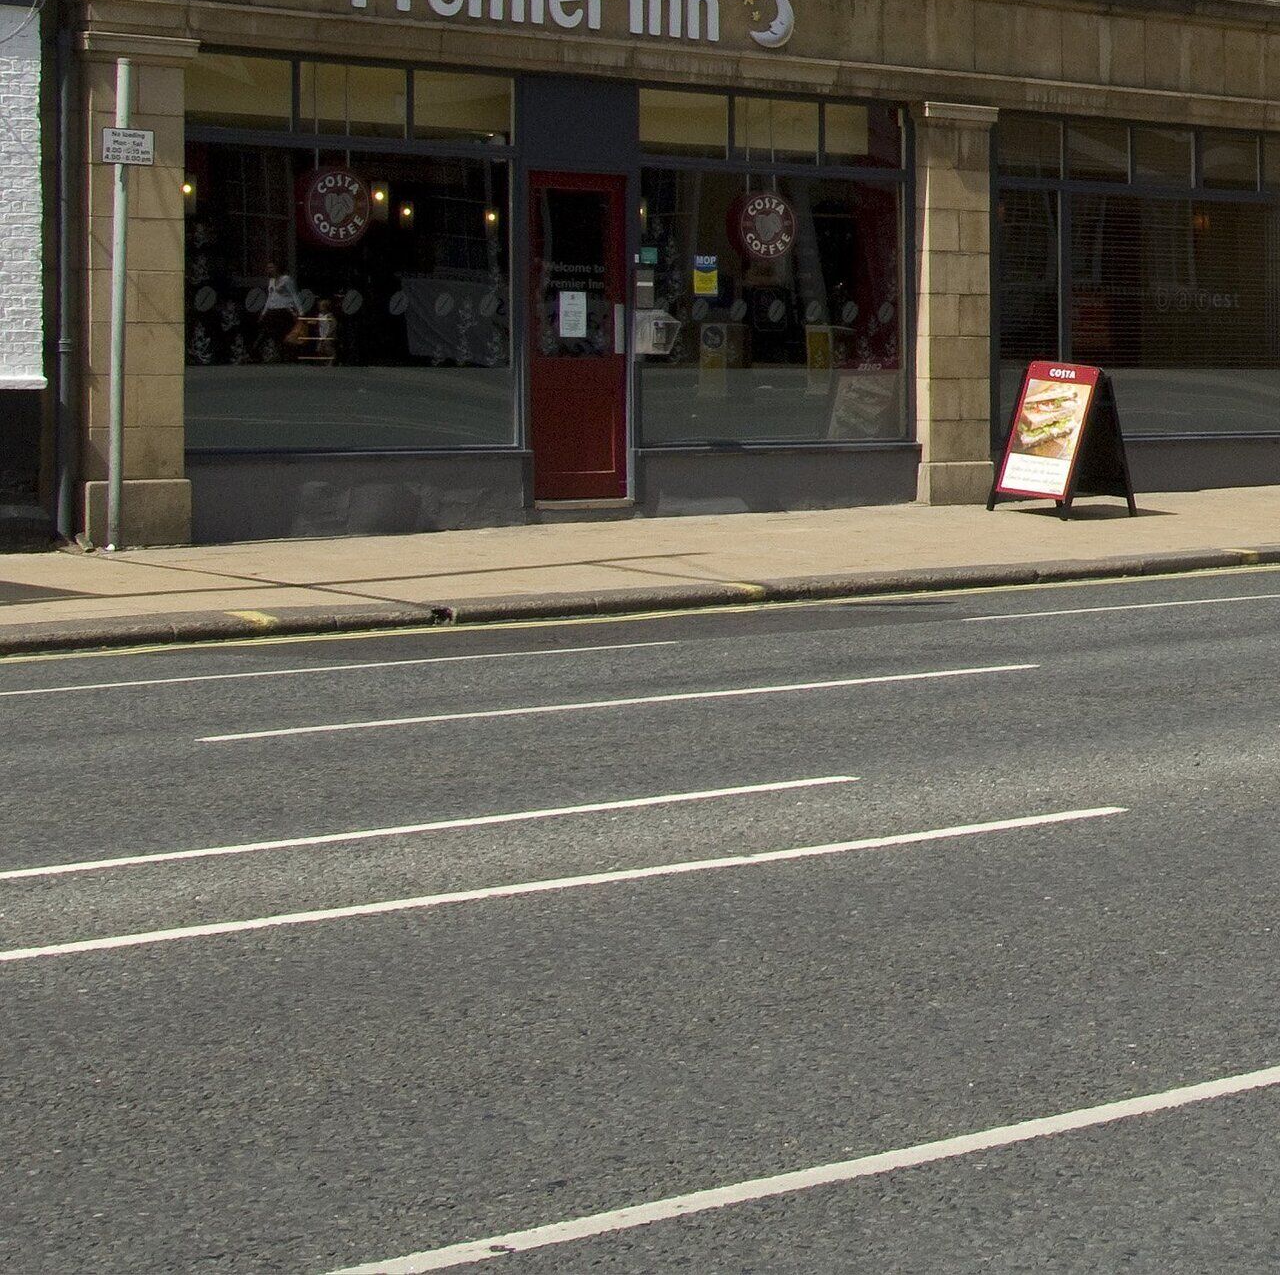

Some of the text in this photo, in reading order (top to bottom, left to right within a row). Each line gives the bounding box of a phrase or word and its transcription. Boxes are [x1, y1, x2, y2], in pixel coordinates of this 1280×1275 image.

[317, 174, 359, 195] COSTA
[748, 197, 785, 216] COSTA
[313, 213, 364, 238] COFFEE
[746, 233, 791, 254] COFFEE
[1049, 368, 1076, 379] COSTA
